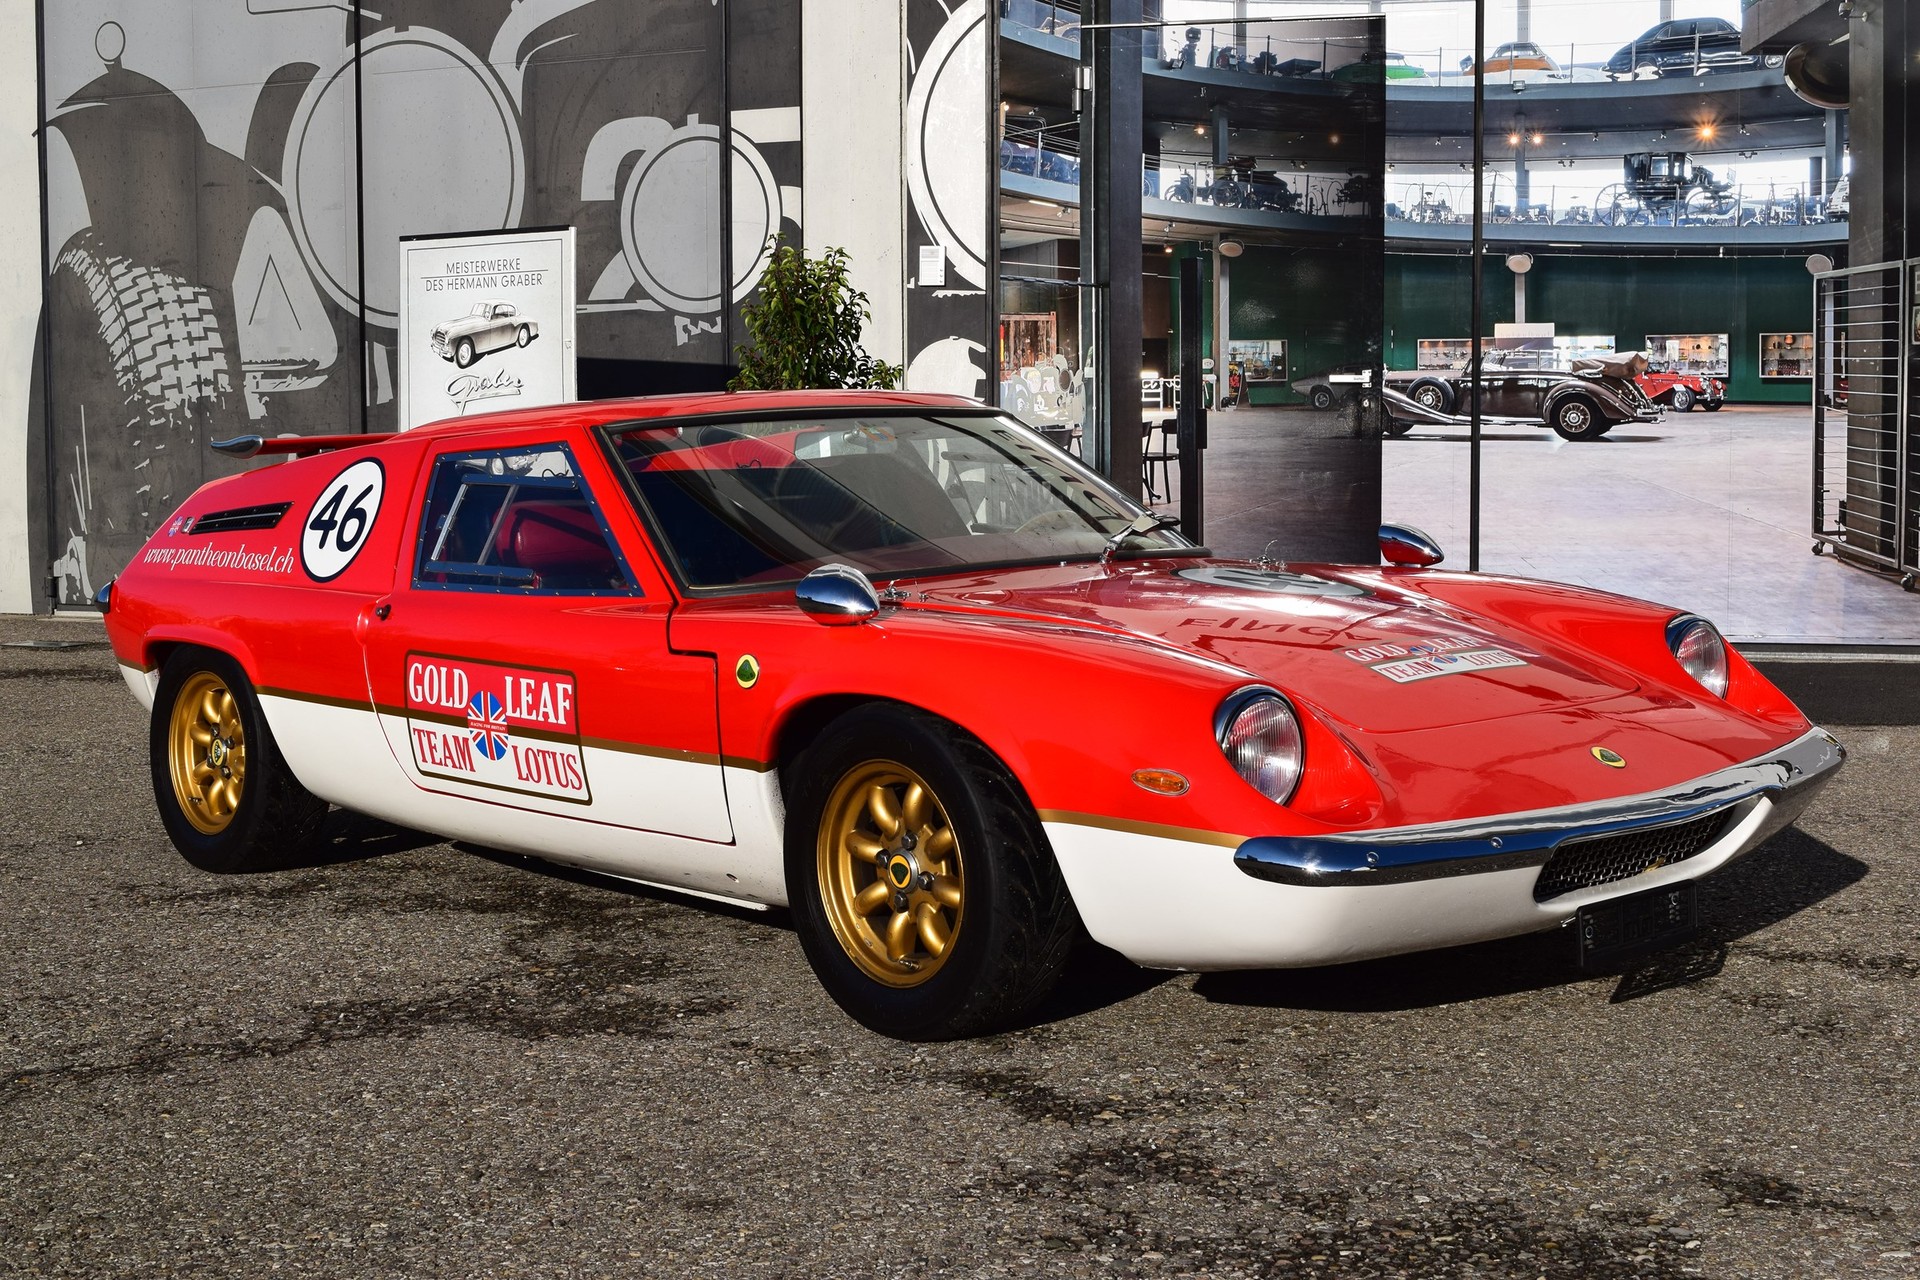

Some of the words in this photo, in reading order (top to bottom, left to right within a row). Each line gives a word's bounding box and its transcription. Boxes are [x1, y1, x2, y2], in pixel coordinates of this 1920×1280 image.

[446, 258, 521, 274] MEISTERWERKE
[425, 279, 444, 292] DES
[447, 276, 498, 290] HERMANN
[501, 273, 543, 288] GRABER
[309, 484, 374, 552] 46
[143, 542, 294, 574] www.pantheonbasel.ch
[1345, 644, 1409, 662] GOLD
[1421, 634, 1487, 653] LEAF
[1378, 660, 1445, 680] TEAM
[1461, 650, 1521, 667] LOTUS
[408, 662, 469, 709] GOLD
[504, 675, 572, 725] LEAF
[413, 728, 476, 772] TEAM
[511, 745, 583, 790] LOTUS
